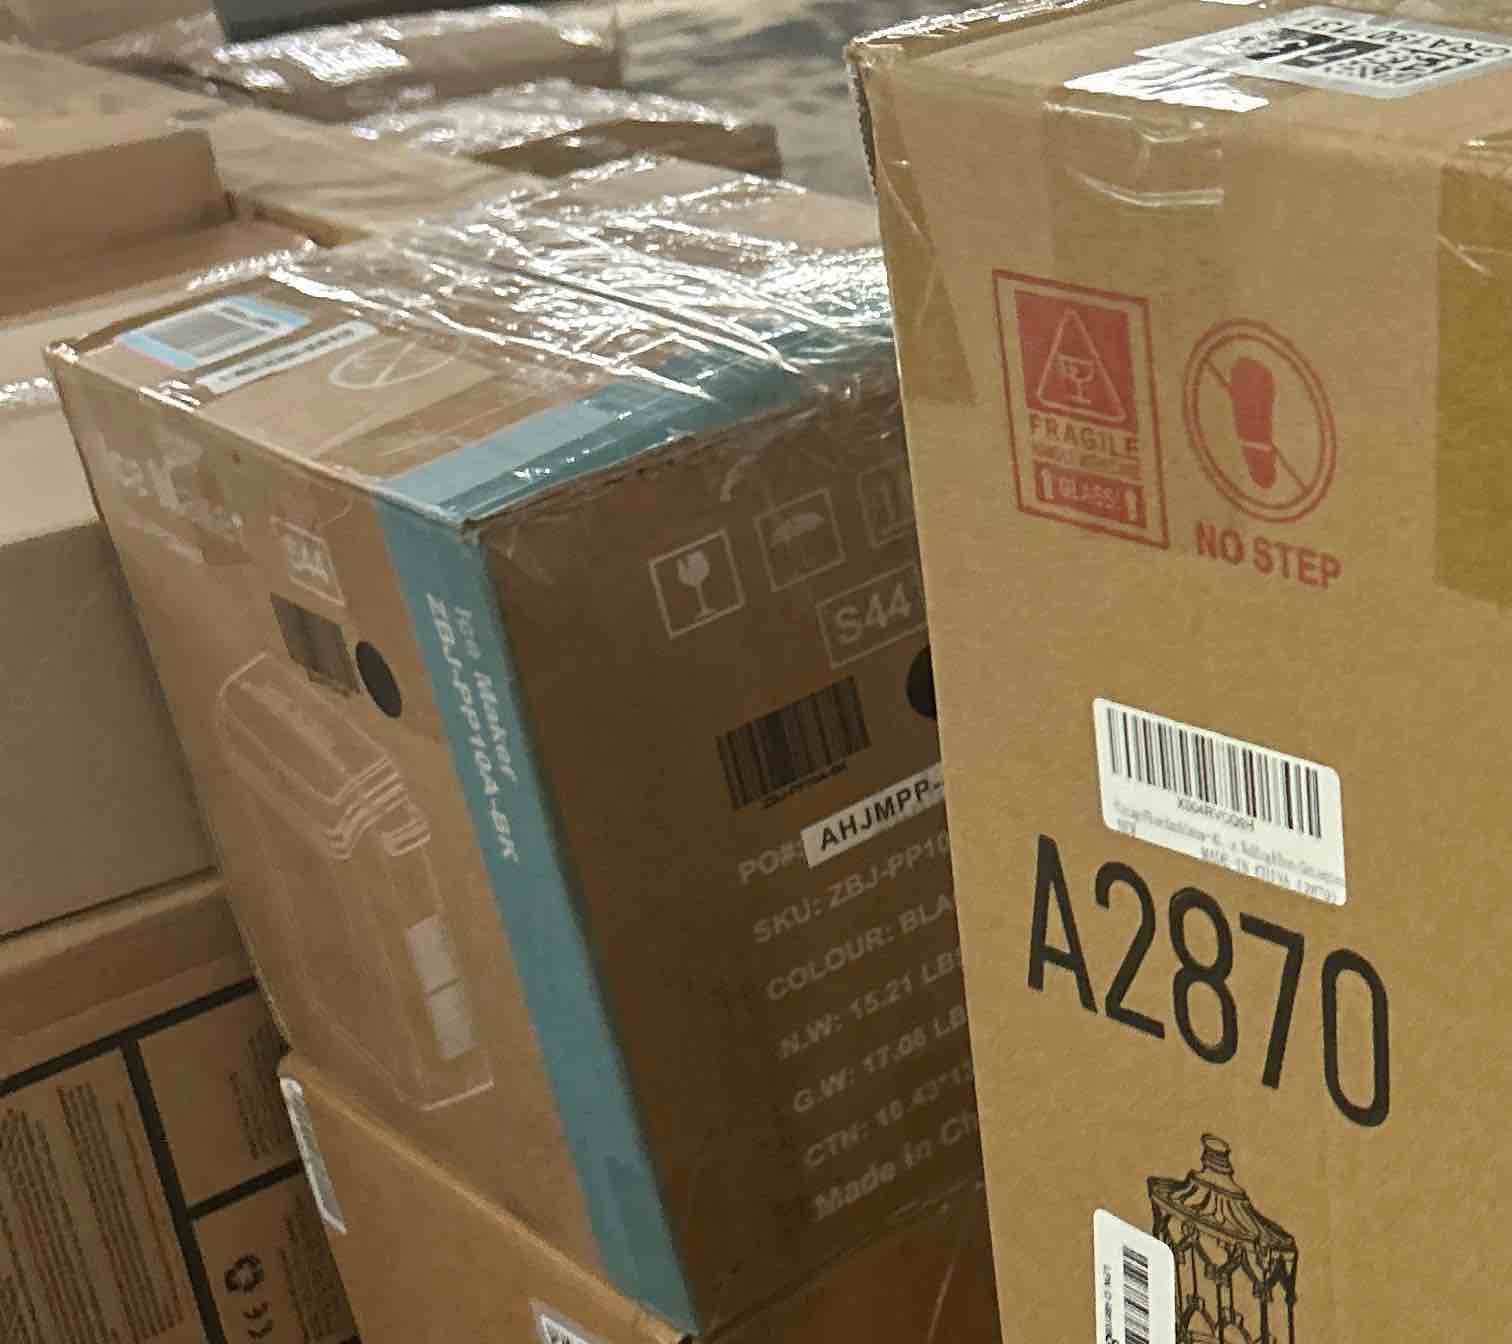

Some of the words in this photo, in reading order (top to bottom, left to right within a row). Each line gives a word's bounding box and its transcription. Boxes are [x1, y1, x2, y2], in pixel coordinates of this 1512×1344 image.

[1029, 413, 1138, 453] FRAGILE
[1195, 521, 1245, 566] NO
[1252, 535, 1342, 591] STEP
[834, 582, 911, 645] S44
[473, 671, 517, 782] Maker
[820, 778, 944, 851] AHJMPP-
[753, 896, 822, 944] SKU:
[766, 927, 895, 1001] COLOUR:
[1028, 833, 1391, 1128] A2870
[780, 1012, 842, 1060] N.W:
[850, 971, 913, 1020] 15.21
[793, 1066, 855, 1113] G.W:
[806, 1119, 870, 1168] CTN:
[813, 1160, 897, 1222] Made
[902, 1139, 933, 1169] in
